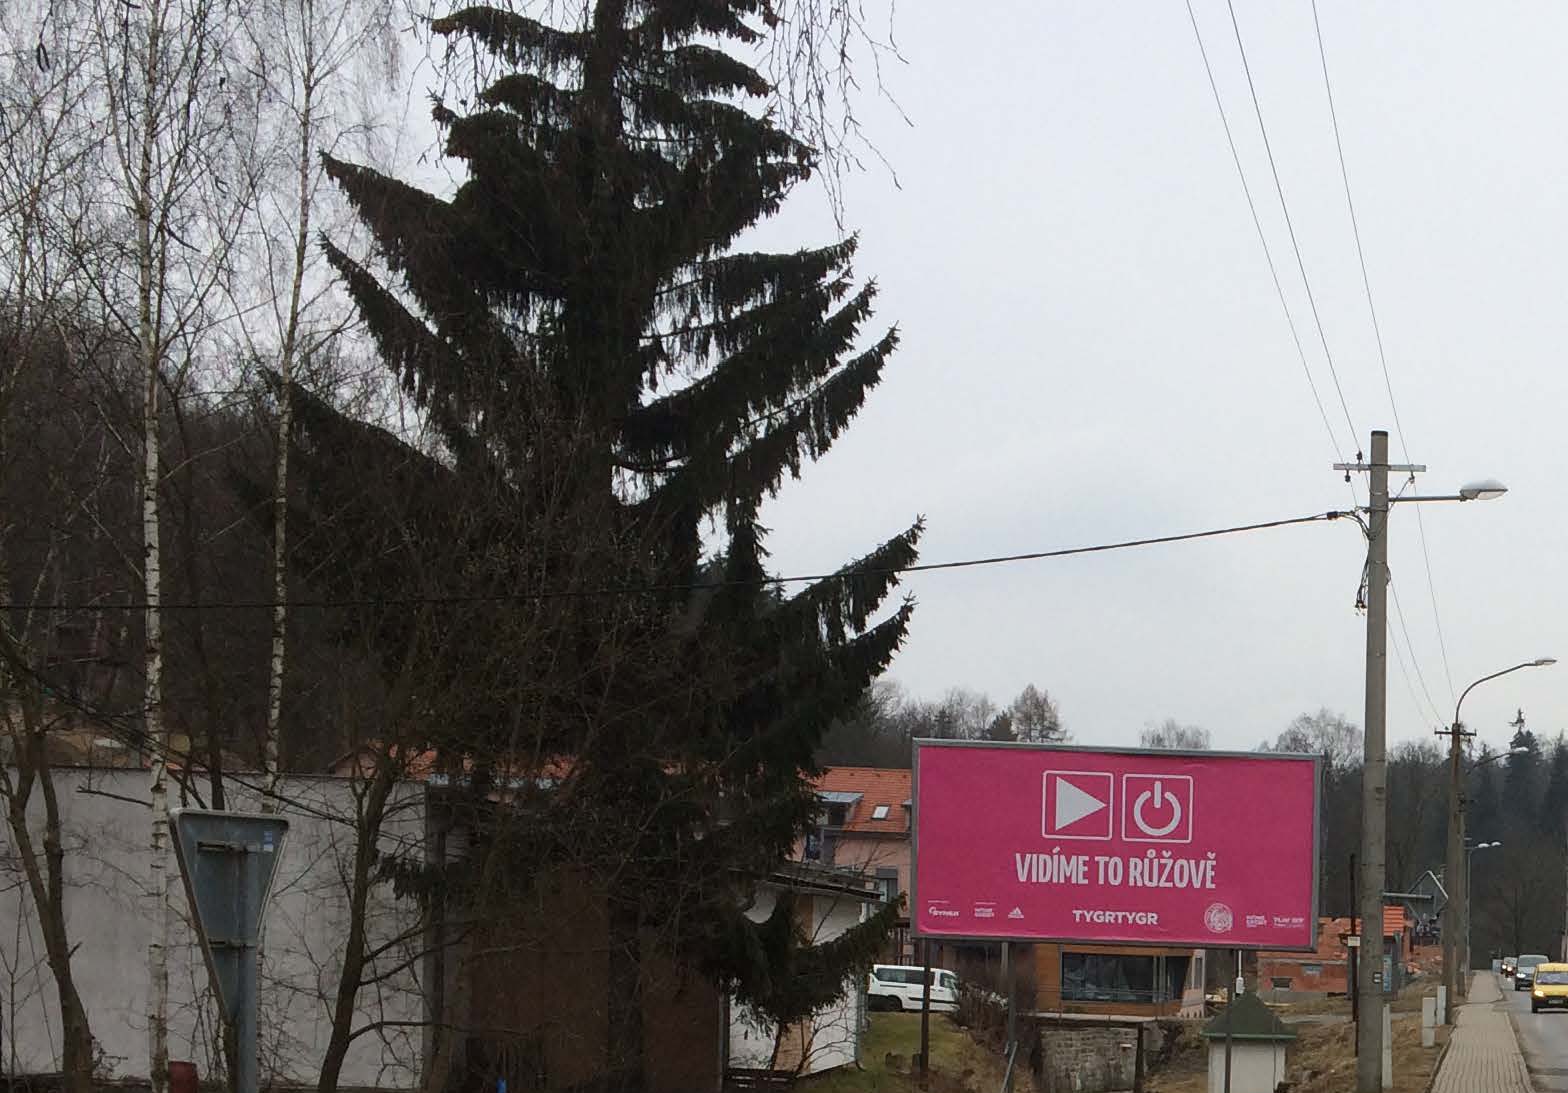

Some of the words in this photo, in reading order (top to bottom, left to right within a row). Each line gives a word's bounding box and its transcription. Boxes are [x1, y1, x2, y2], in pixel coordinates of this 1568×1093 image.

[1015, 846, 1090, 885] VIDÍME
[1094, 856, 1123, 886] TO
[1128, 849, 1217, 889] RŮŽOVĚ
[1072, 909, 1159, 925] TYGRTYGR
